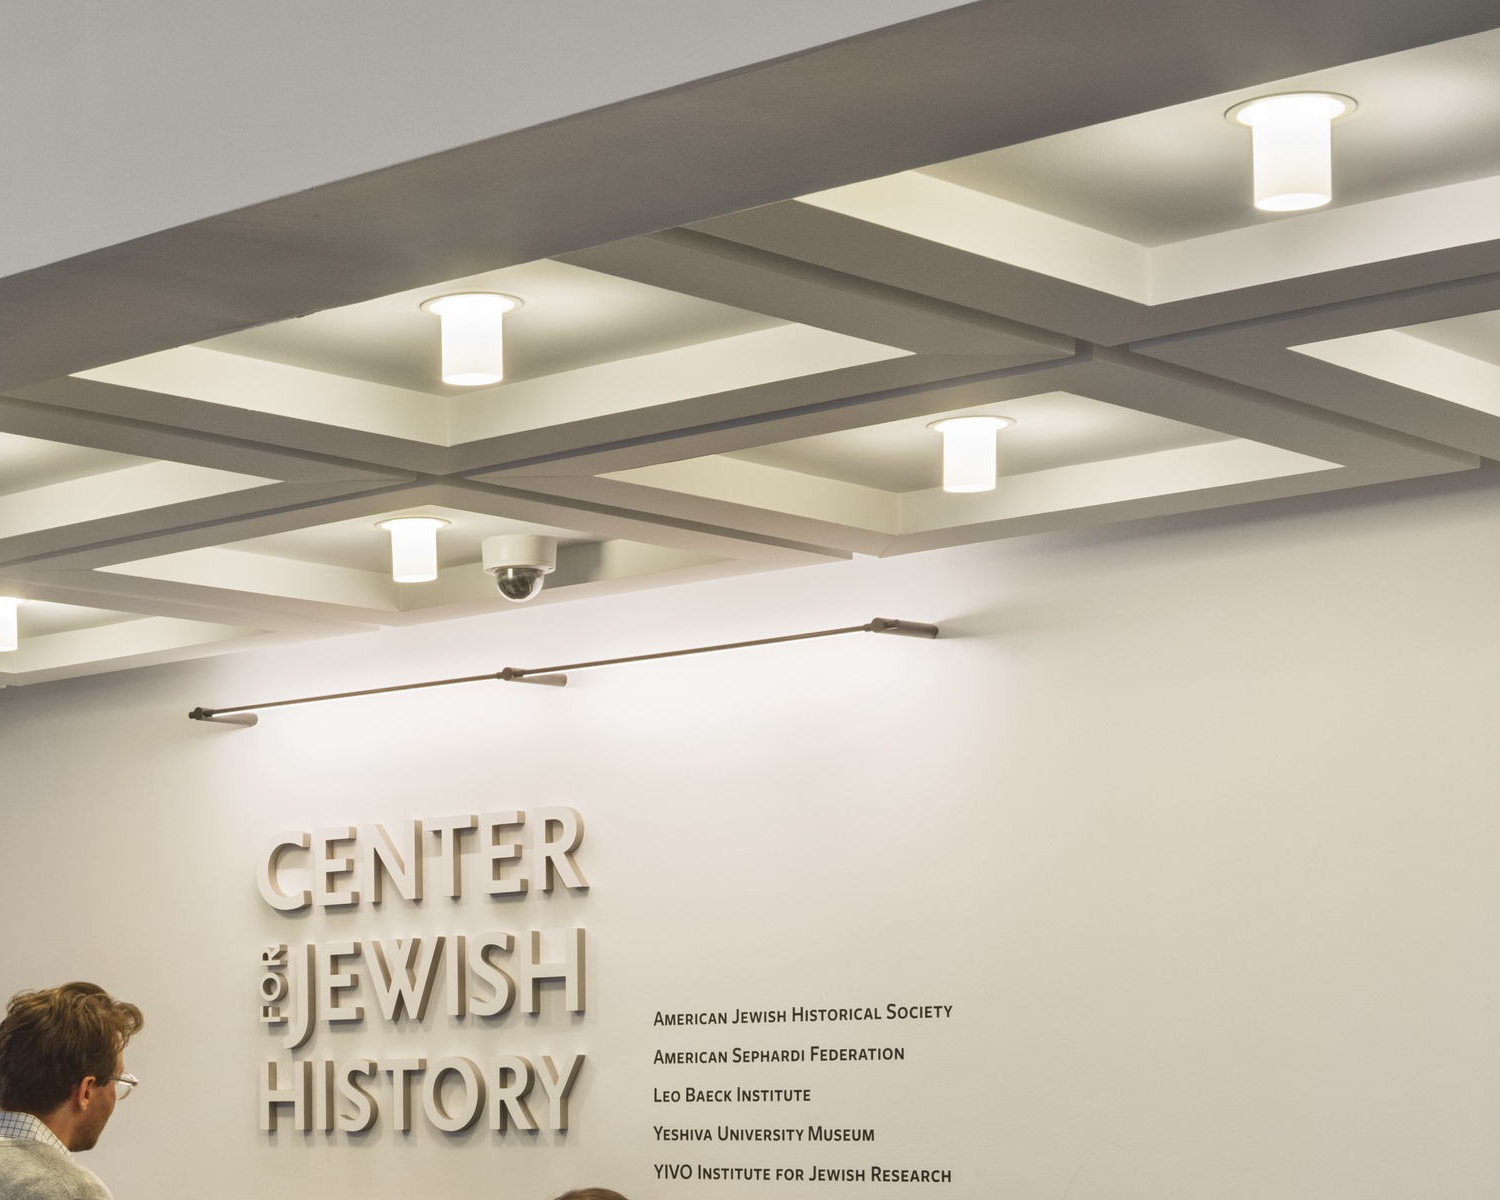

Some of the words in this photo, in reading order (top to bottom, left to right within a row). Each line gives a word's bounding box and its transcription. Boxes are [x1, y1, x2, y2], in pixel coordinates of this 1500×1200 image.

[257, 805, 590, 911] CENTER
[259, 944, 288, 1024] FOR
[283, 927, 586, 1050] JEWISH
[653, 1011, 728, 1027] AMERICAN
[731, 1008, 787, 1025] JEWISH
[792, 1006, 882, 1023] HISTORICAL
[886, 1003, 953, 1020] SOCIETY
[653, 1049, 728, 1065] AMERICAN
[732, 1047, 805, 1064] SEPHARDI
[810, 1045, 905, 1062] FEDERATION
[259, 1054, 586, 1133] HISTORY
[653, 1087, 681, 1103] LEO
[685, 1087, 733, 1103] BAECK
[737, 1086, 811, 1102] INSTITUTE
[653, 1125, 713, 1142] YESHIVA
[717, 1125, 805, 1142] UNIVERSITY
[808, 1125, 875, 1142] MUSEUM
[653, 1163, 693, 1180] YIVO
[697, 1164, 771, 1181] INSTITUTE
[775, 1168, 804, 1181] FOR
[808, 1165, 866, 1182] JEWISH
[871, 1165, 952, 1183] RESEARCH
